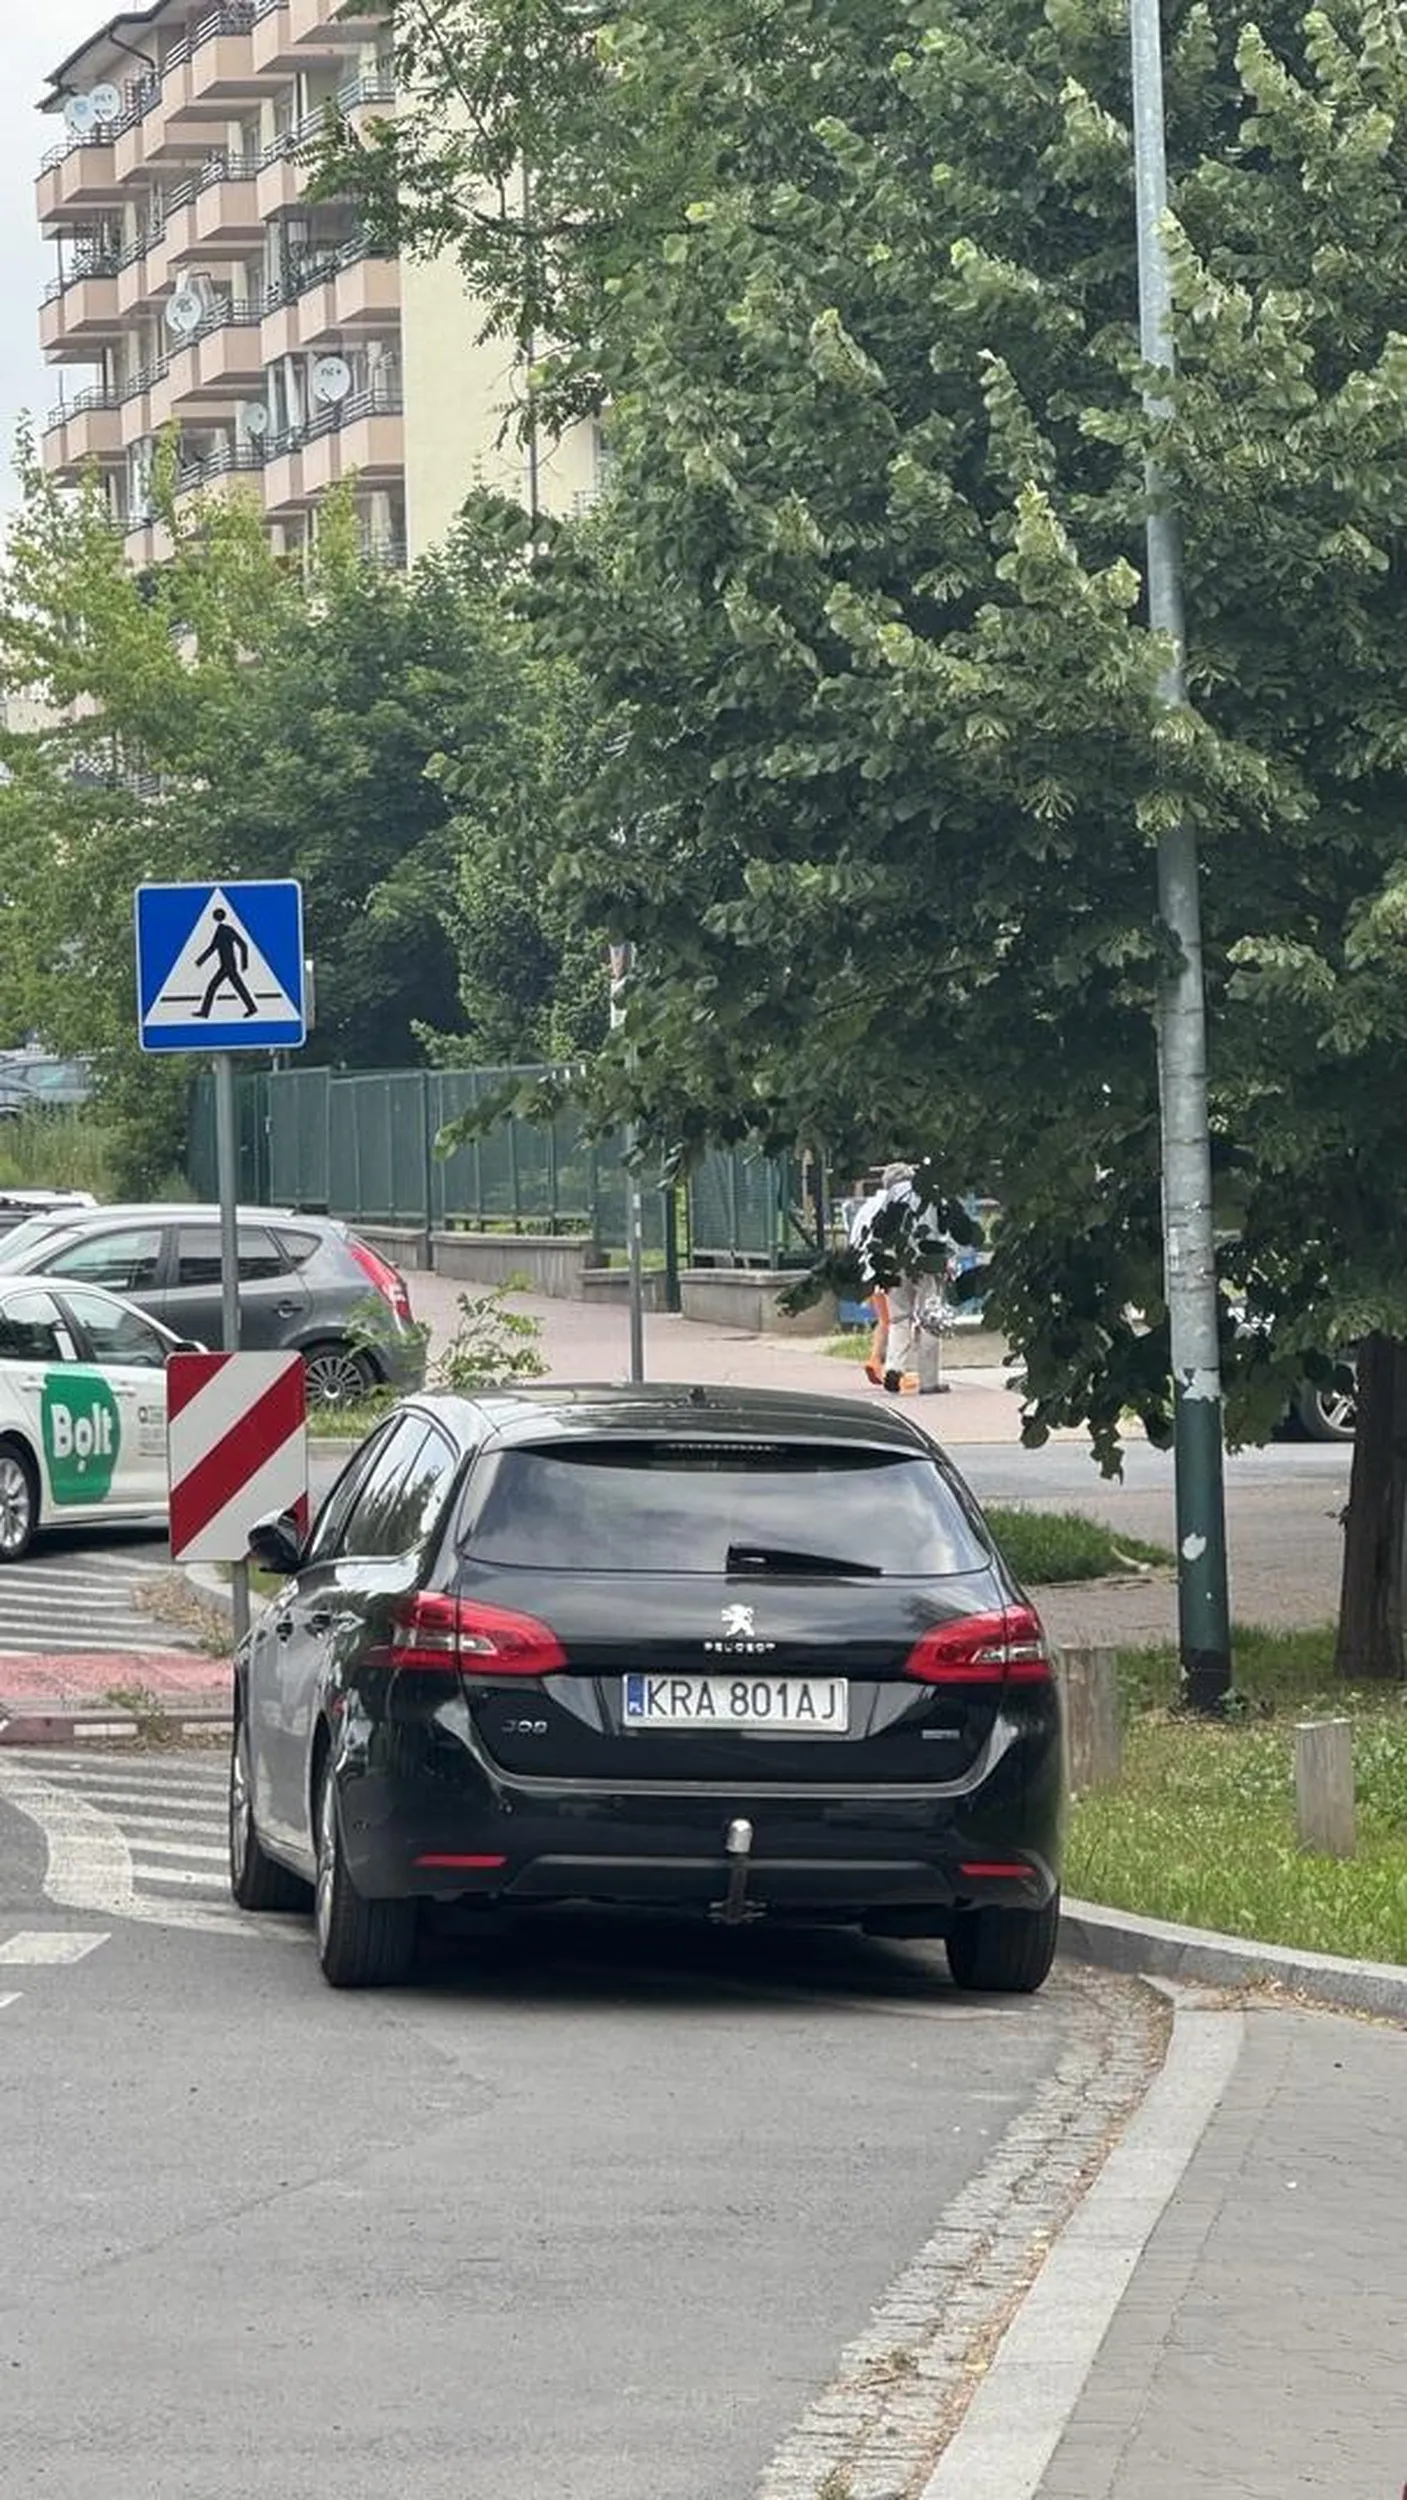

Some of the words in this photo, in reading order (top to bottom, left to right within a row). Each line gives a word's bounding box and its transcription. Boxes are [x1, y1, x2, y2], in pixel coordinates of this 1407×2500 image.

[50, 1402, 112, 1459] Bolt
[647, 1680, 716, 1716] KRA
[730, 1682, 836, 1719] 801AJ
